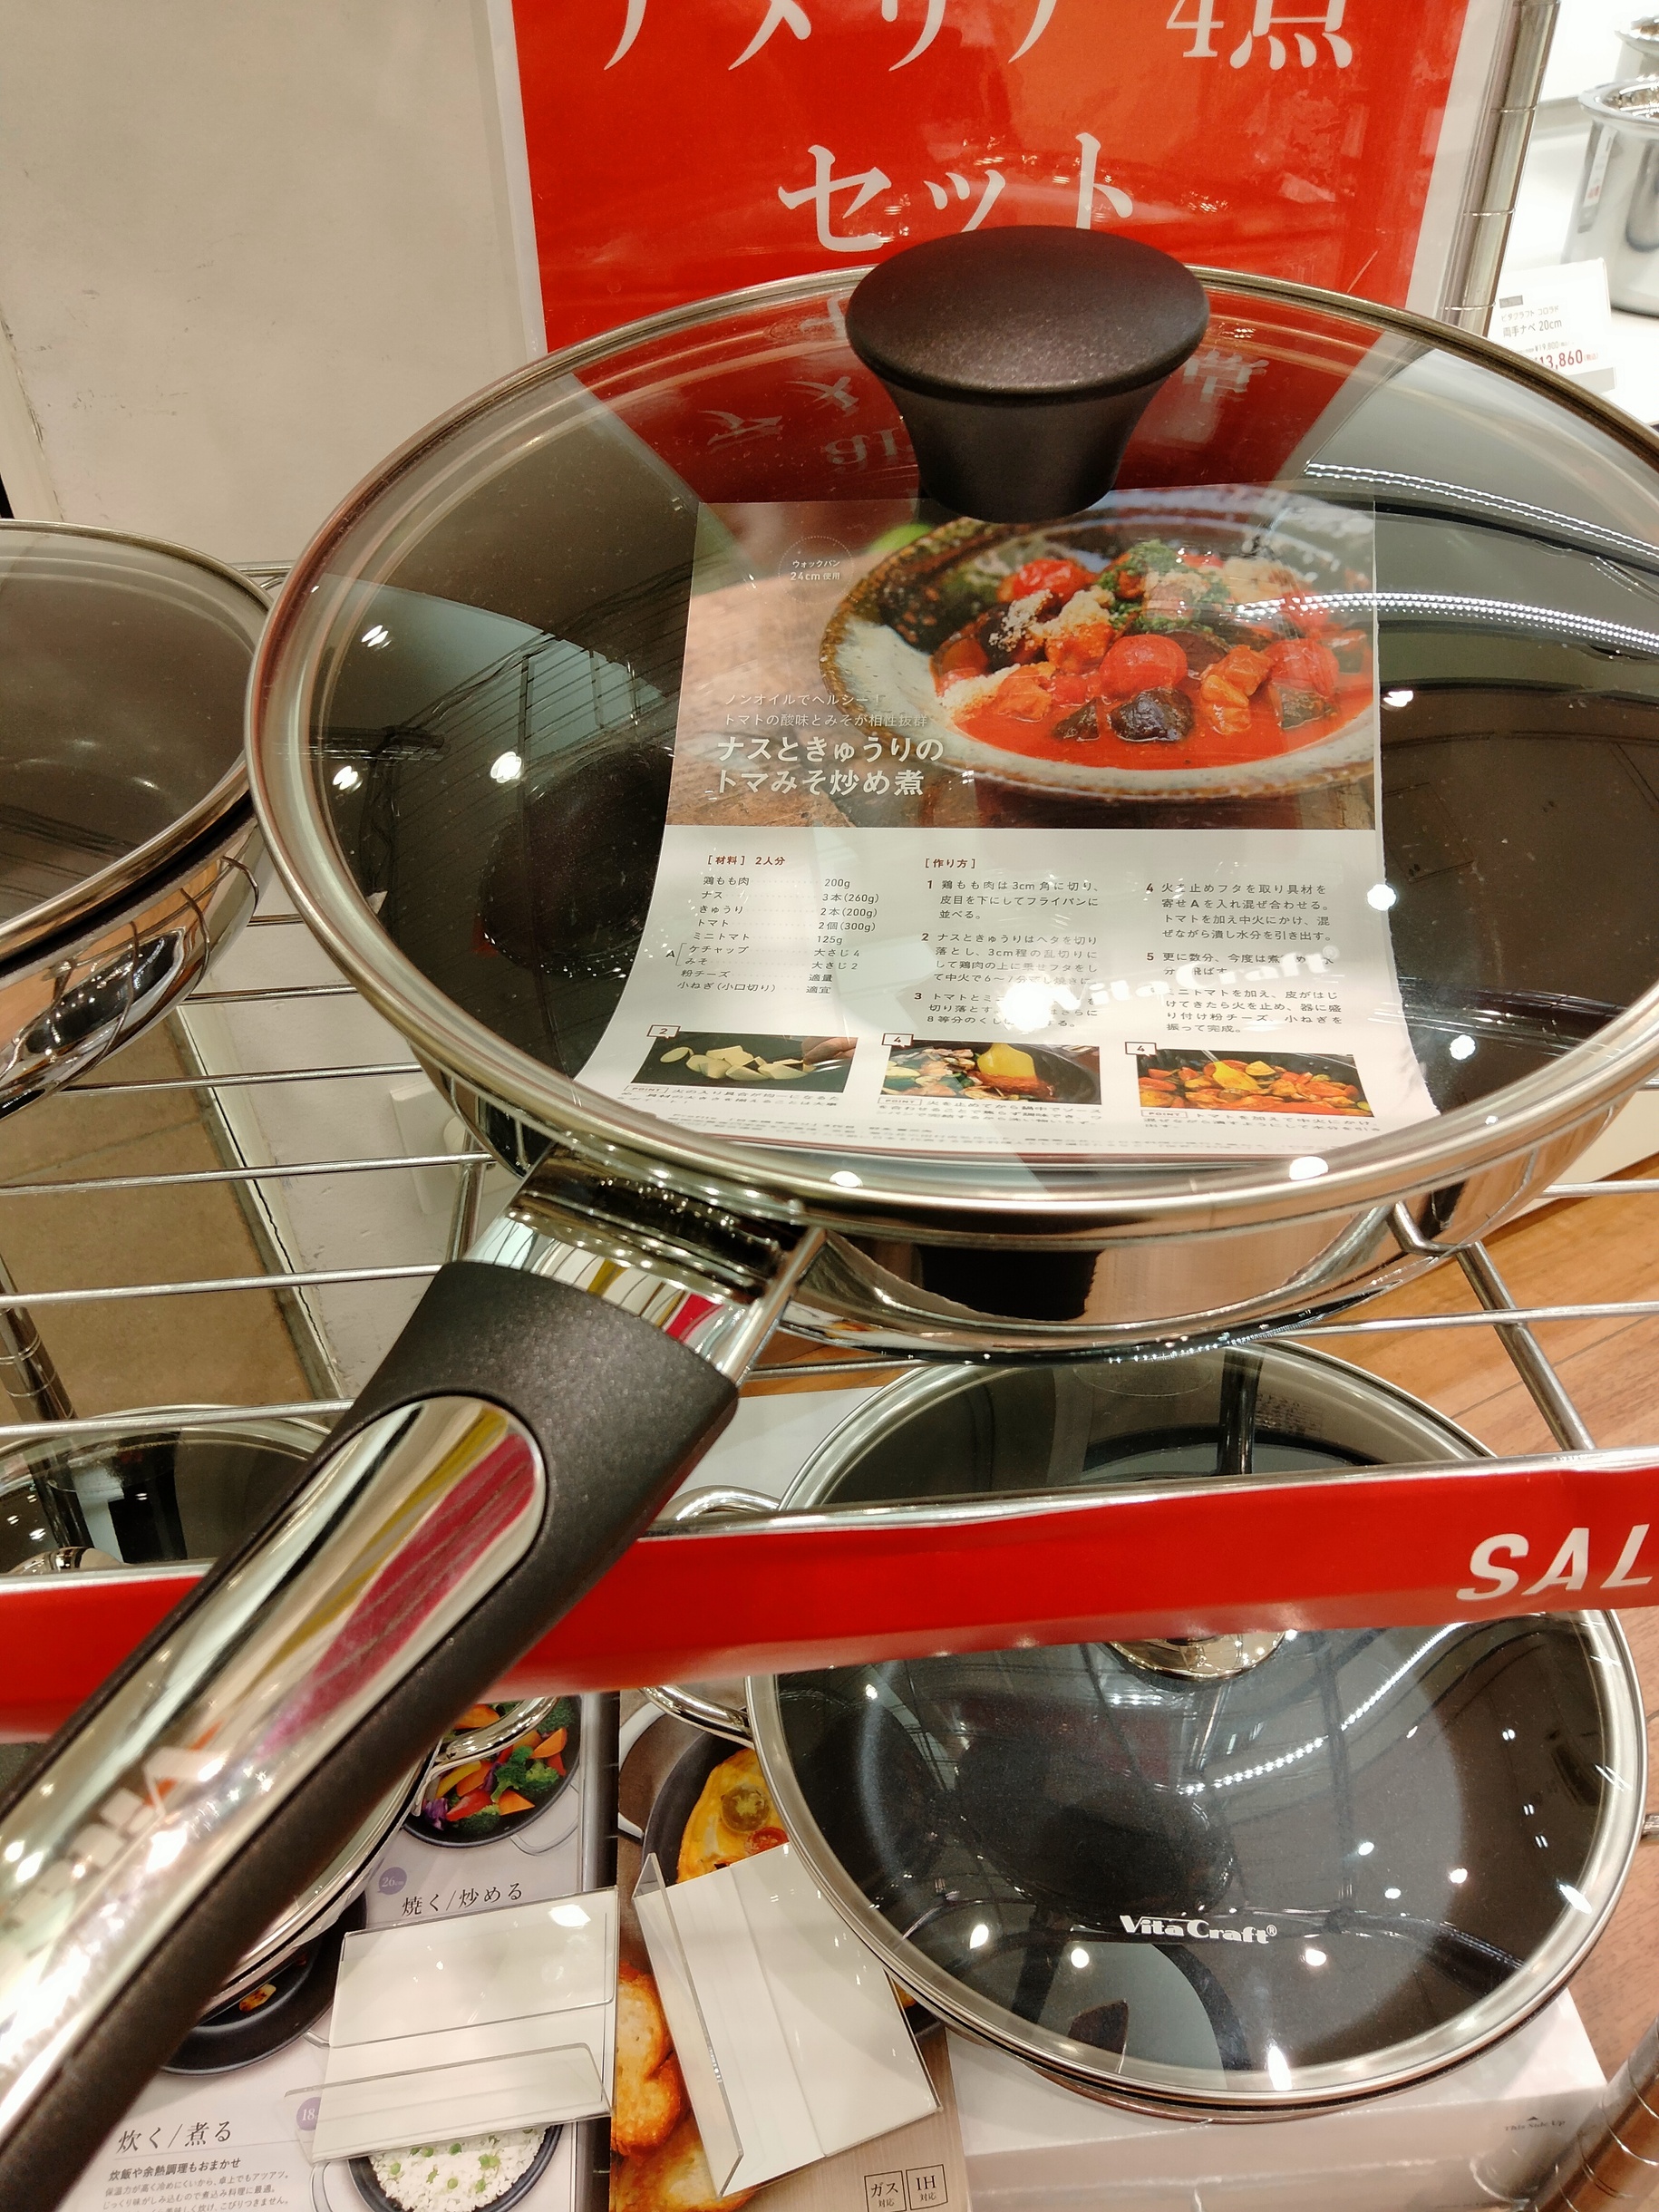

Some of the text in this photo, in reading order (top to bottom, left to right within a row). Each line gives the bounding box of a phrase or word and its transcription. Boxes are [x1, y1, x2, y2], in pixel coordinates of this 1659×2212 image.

[778, 132, 1133, 252] セット
[1538, 319, 1562, 331] 20cm
[1535, 349, 1583, 370] 13,860
[790, 571, 840, 581] 24cm 使用
[725, 713, 928, 727] トマトの酸味とみそが相性抜群
[717, 736, 944, 762] ナスときゅうりの
[719, 769, 925, 796] トマみそ炒め煮
[755, 856, 786, 865] 2人分
[703, 876, 850, 889] 鶏もも肉 200g
[927, 879, 934, 889] 1
[1146, 883, 1154, 893] 4
[701, 890, 723, 899] ナス
[940, 895, 1098, 907] 皮目を下にしてフライパンに
[699, 905, 745, 914] きゅうり
[938, 910, 981, 920] 並べる。
[697, 918, 730, 927] トマト
[1165, 914, 1330, 926] トマトを加え中火にかけ、混
[693, 931, 843, 946] ミニトマト 125g
[921, 933, 1098, 946] 2 ナスときゅうりはヘタを切り
[1161, 929, 1332, 941] ぜながら潰し水分を引き出す。
[665, 950, 675, 958] A
[689, 945, 750, 955] ケチャップ
[813, 947, 849, 957] 大さじ
[1147, 953, 1154, 961] 5
[684, 957, 708, 965] みそ
[811, 961, 848, 970] 大さじ
[680, 969, 833, 982] 粉チーズ 適量
[1167, 1024, 1241, 1033] 振って完成。
[1456, 1524, 1654, 1601] SAL
[402, 1882, 523, 1917] 焼く/炒める
[115, 2120, 233, 2155] 炊く/煮る
[108, 2157, 242, 2182] 炊飯や余熱調理もおまかせ
[916, 2175, 936, 2191] IH
[870, 2181, 898, 2198] ガス
[878, 2197, 895, 2208] 対応
[919, 2192, 937, 2202] 対応
